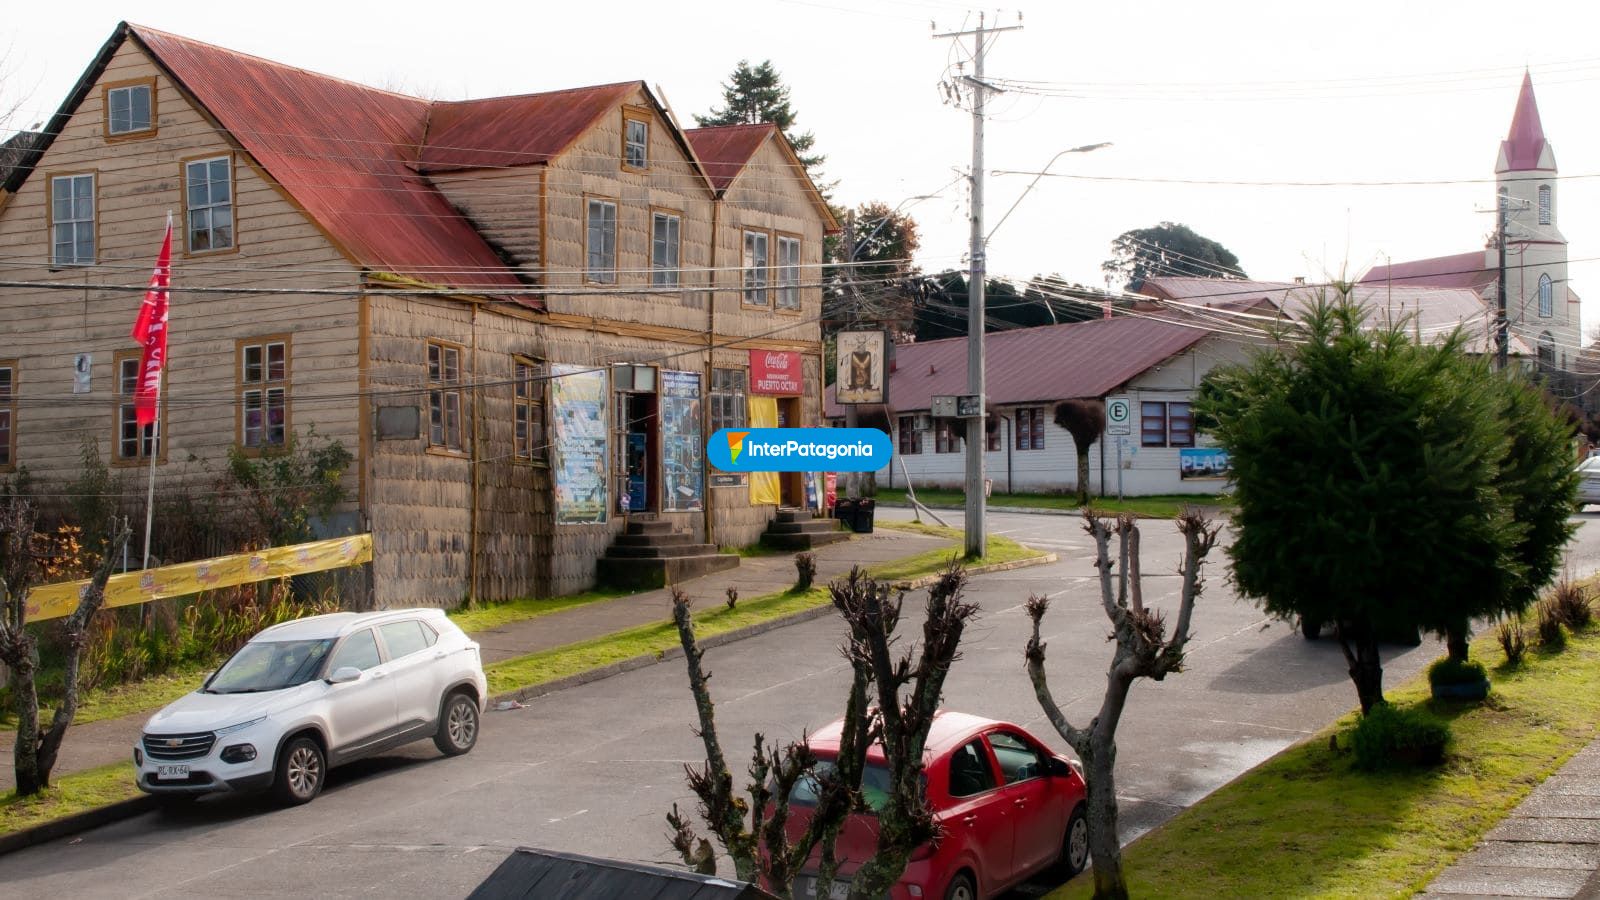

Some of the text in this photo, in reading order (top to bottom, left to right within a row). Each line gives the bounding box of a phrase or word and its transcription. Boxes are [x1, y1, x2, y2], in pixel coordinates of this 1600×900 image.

[757, 380, 798, 391] PUERTO OCTAY
[1114, 405, 1123, 418] E
